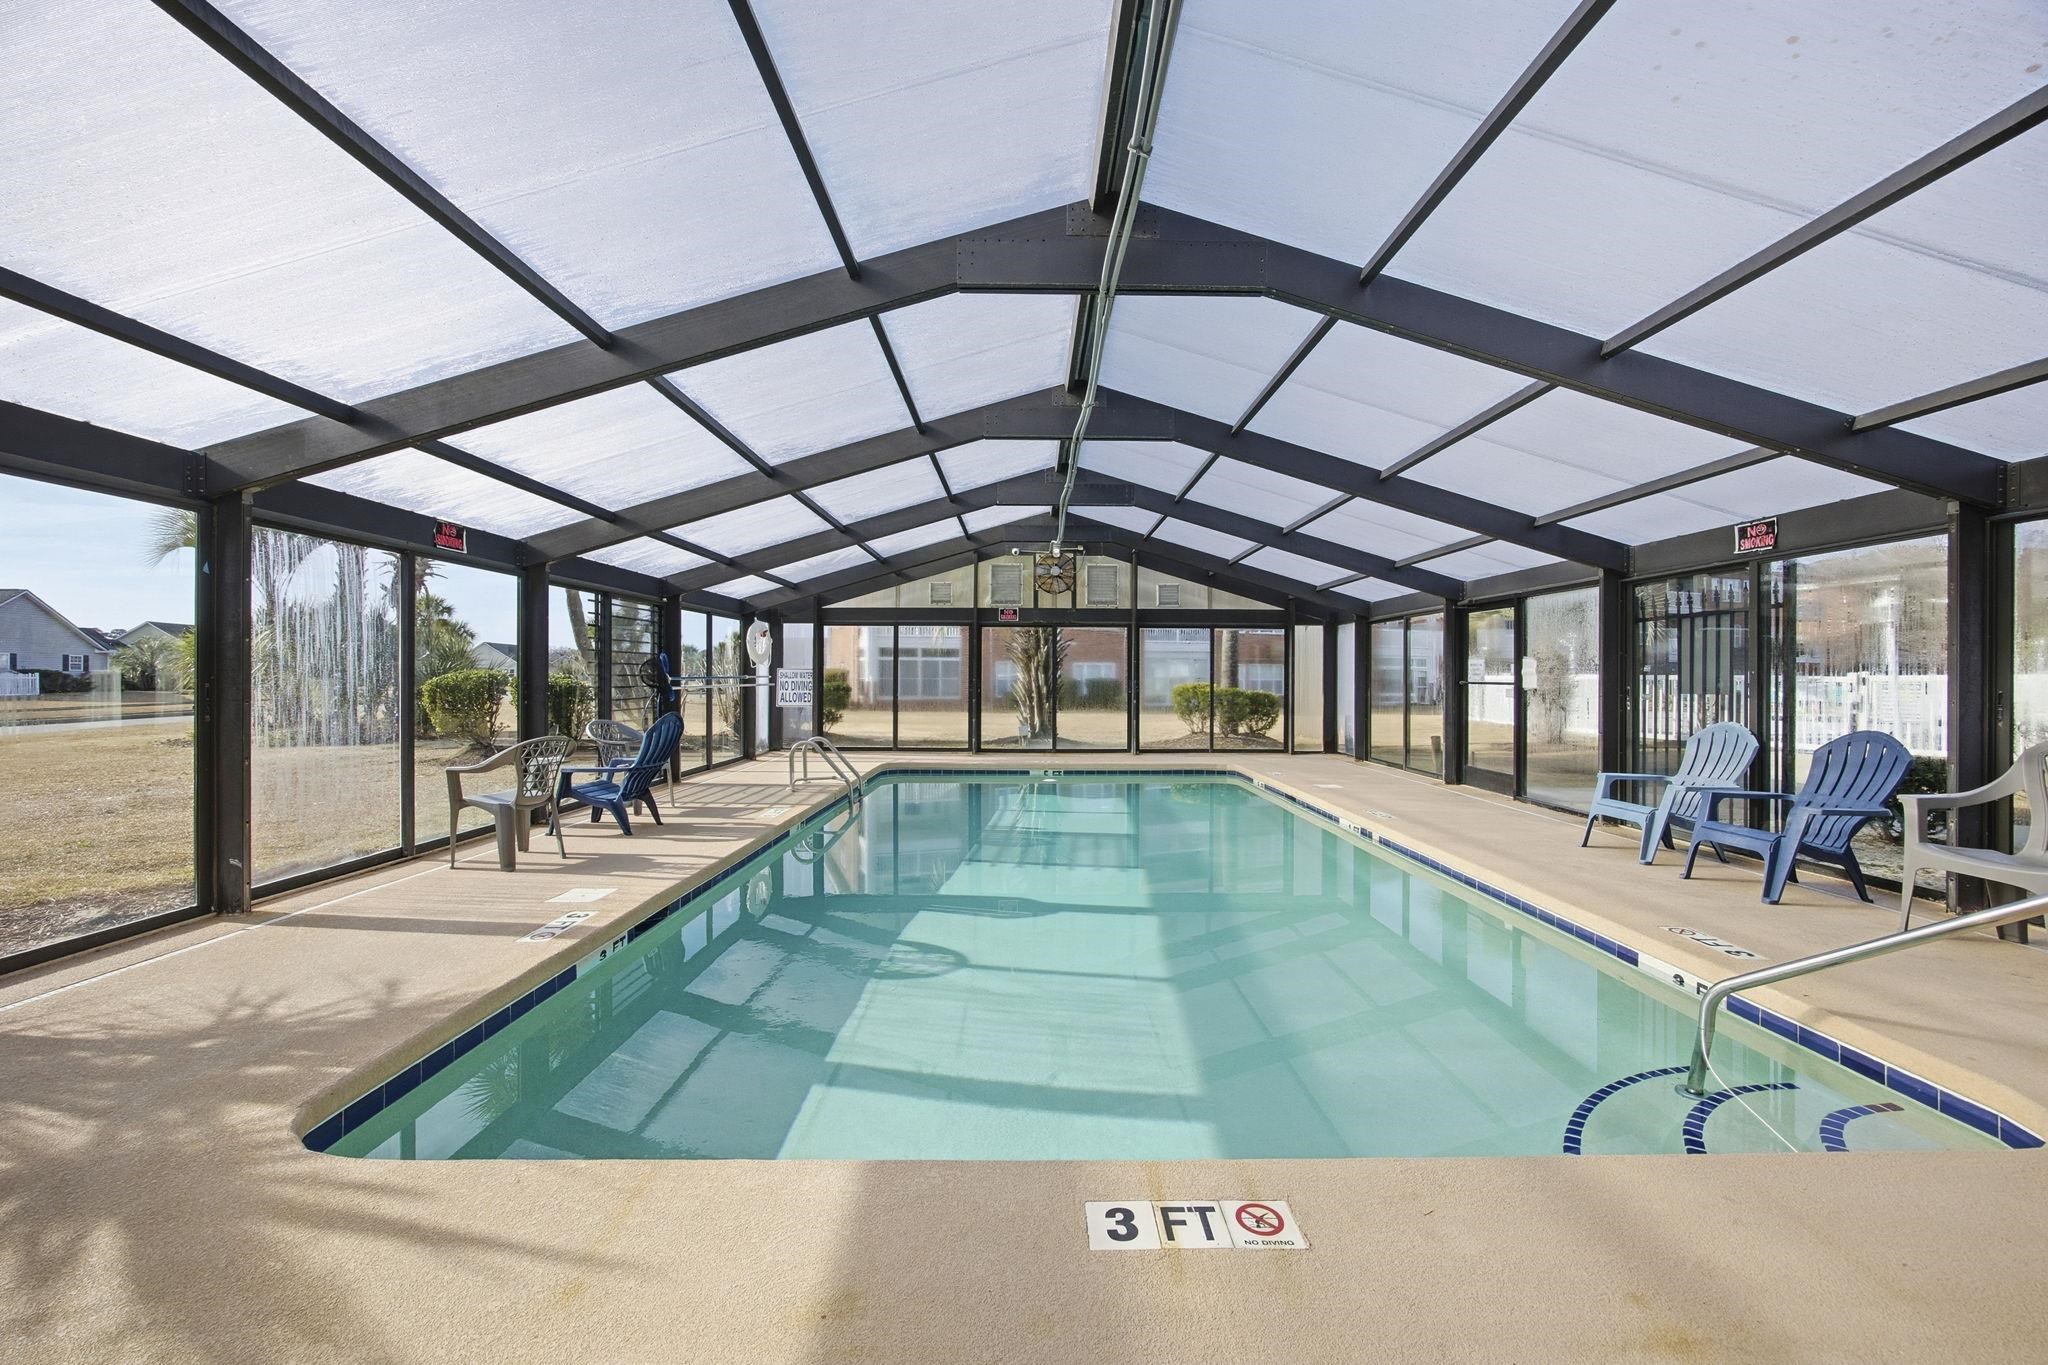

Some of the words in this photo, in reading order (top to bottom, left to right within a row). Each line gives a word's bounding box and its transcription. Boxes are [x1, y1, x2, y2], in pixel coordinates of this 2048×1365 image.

[1747, 523, 1767, 538] NO
[1740, 533, 1774, 550] SMOKING
[780, 680, 789, 691] NO
[790, 680, 813, 691] DIVING
[779, 692, 812, 703] ALLOWED
[599, 949, 608, 962] 3
[612, 935, 626, 952] FT
[1105, 1207, 1139, 1242] 3
[1160, 1206, 1216, 1241] FT
